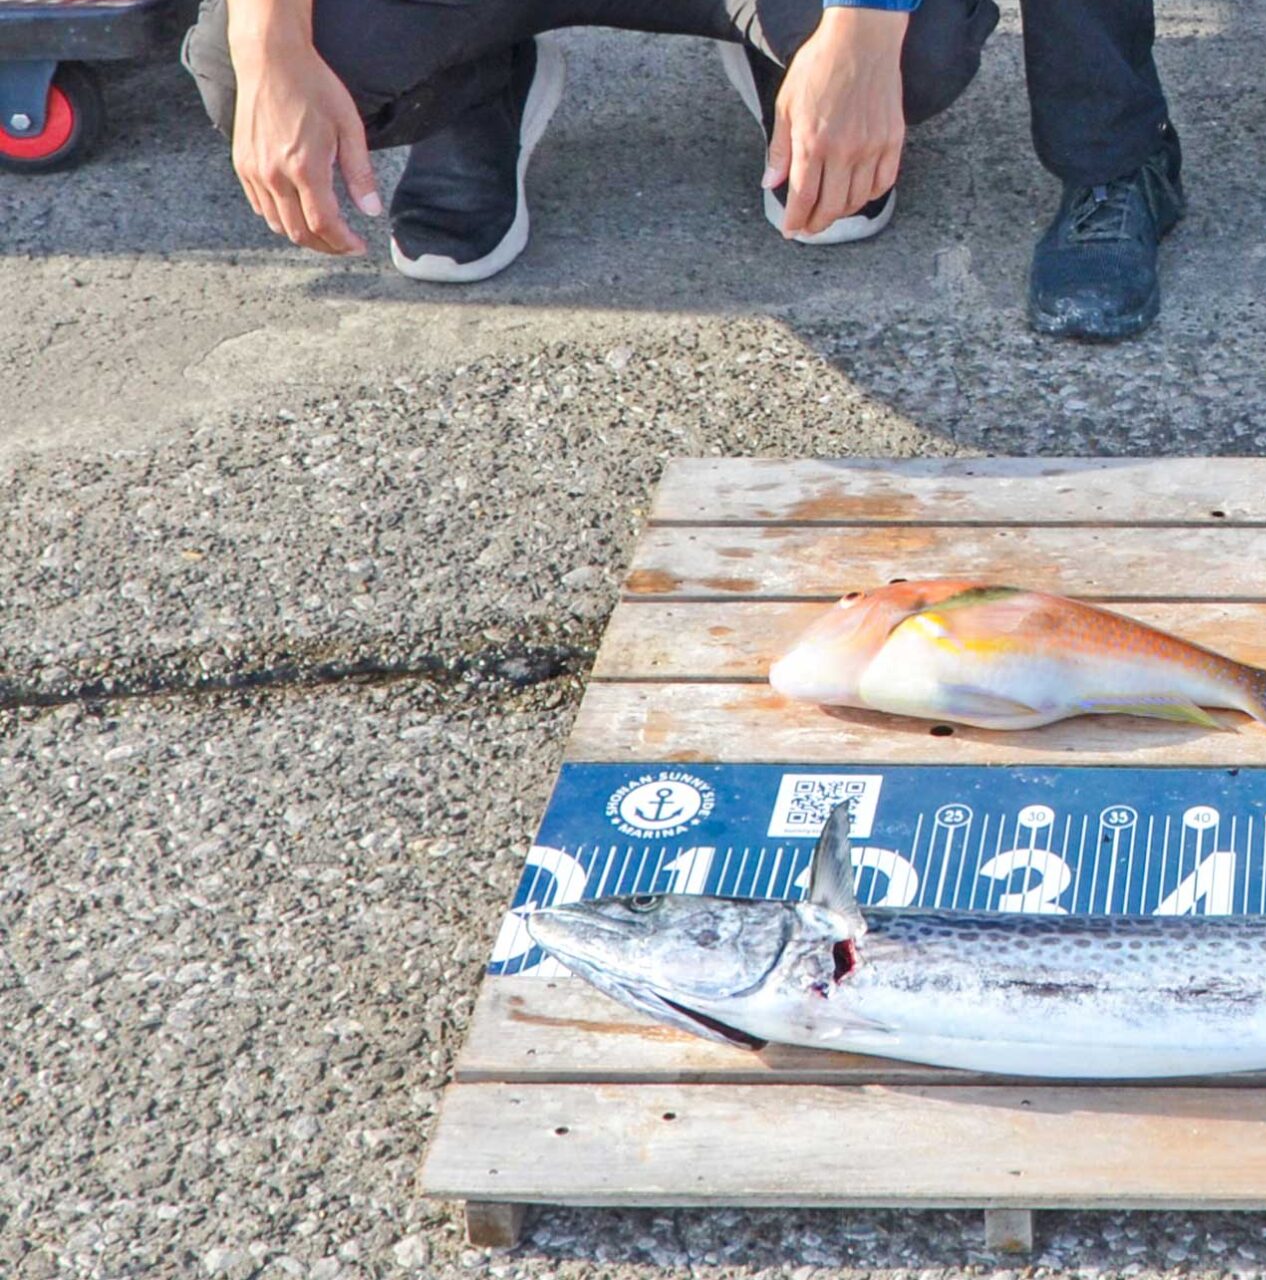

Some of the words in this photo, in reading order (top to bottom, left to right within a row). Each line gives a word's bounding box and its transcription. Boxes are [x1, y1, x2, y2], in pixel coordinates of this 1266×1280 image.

[605, 774, 653, 817] SHONAN
[659, 771, 711, 792] SUNNY
[698, 791, 716, 819] SIDE
[943, 810, 964, 822] 25
[1027, 811, 1046, 822] 30
[1109, 811, 1129, 823] 35
[1193, 812, 1211, 823] 40
[617, 823, 689, 840] MARINA
